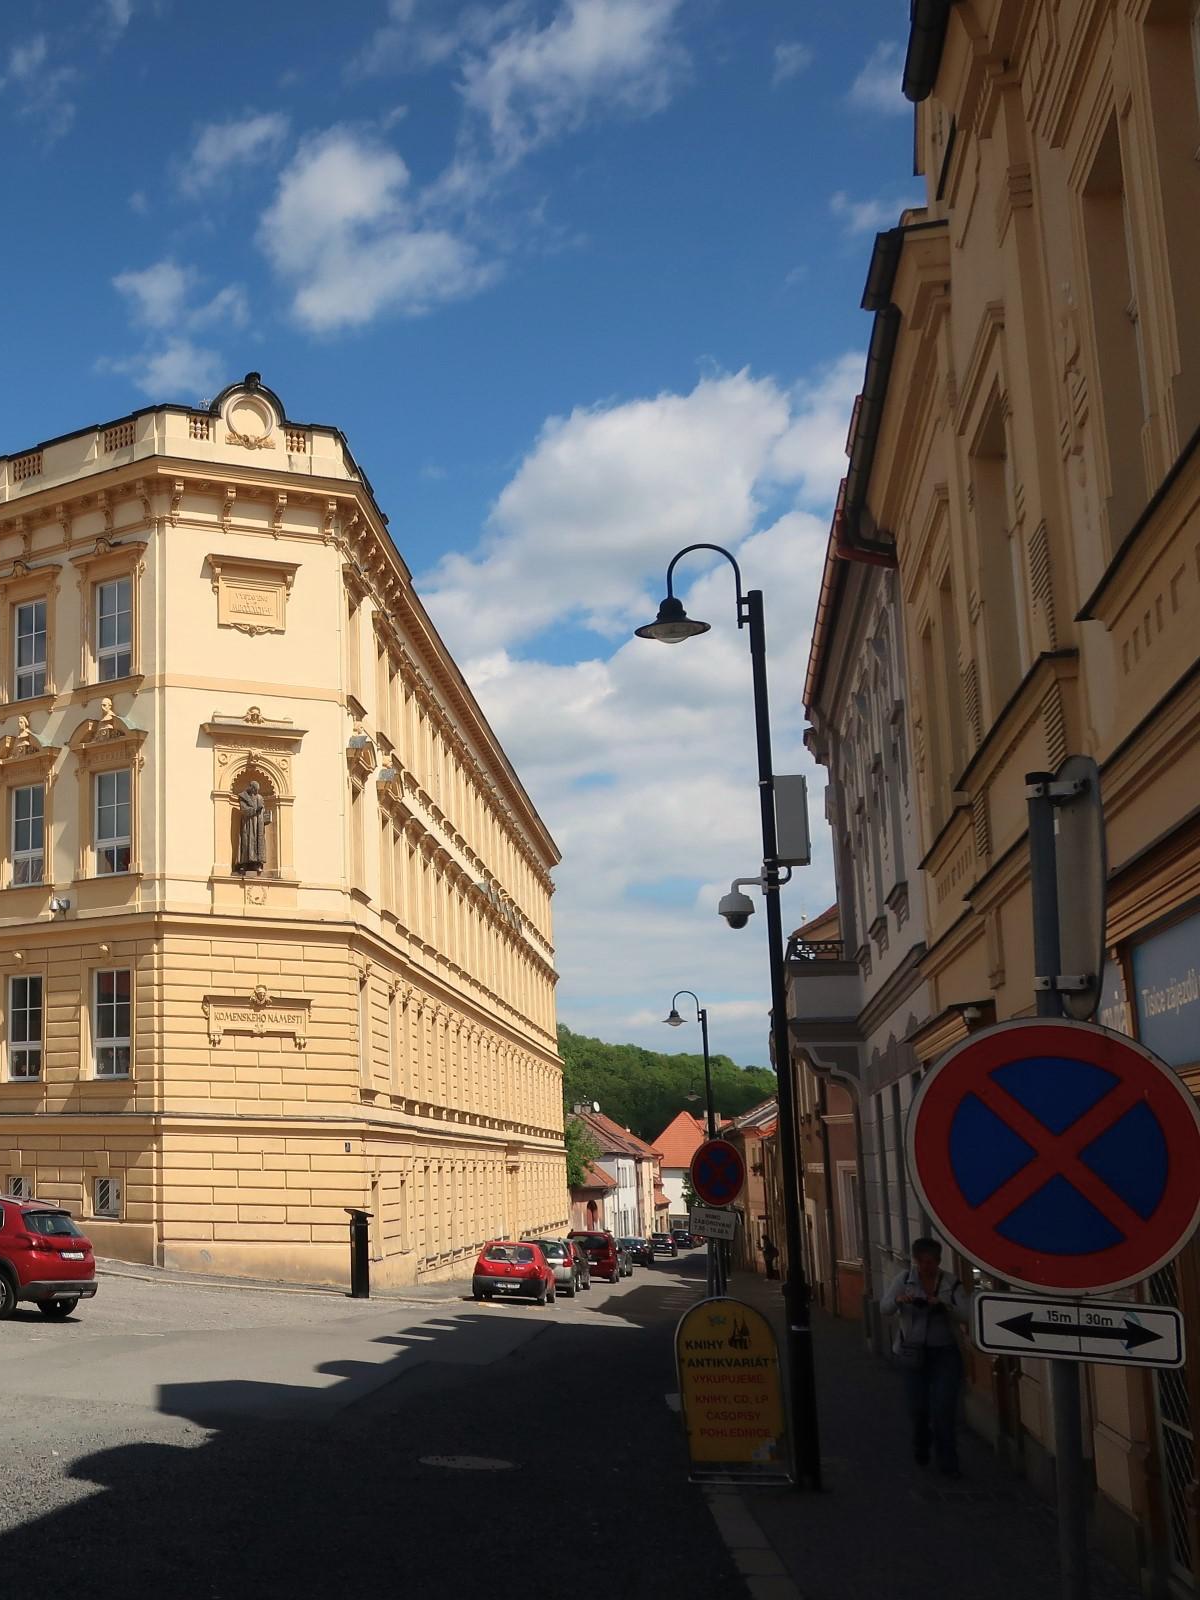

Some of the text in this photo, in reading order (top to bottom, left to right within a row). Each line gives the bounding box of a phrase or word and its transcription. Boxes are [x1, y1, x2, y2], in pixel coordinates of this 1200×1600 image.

[1046, 1310, 1114, 1327] 15m 30m
[685, 1339, 724, 1351] KNIHY
[755, 1394, 769, 1404] LP
[700, 1427, 771, 1438] POHLEDNICE
